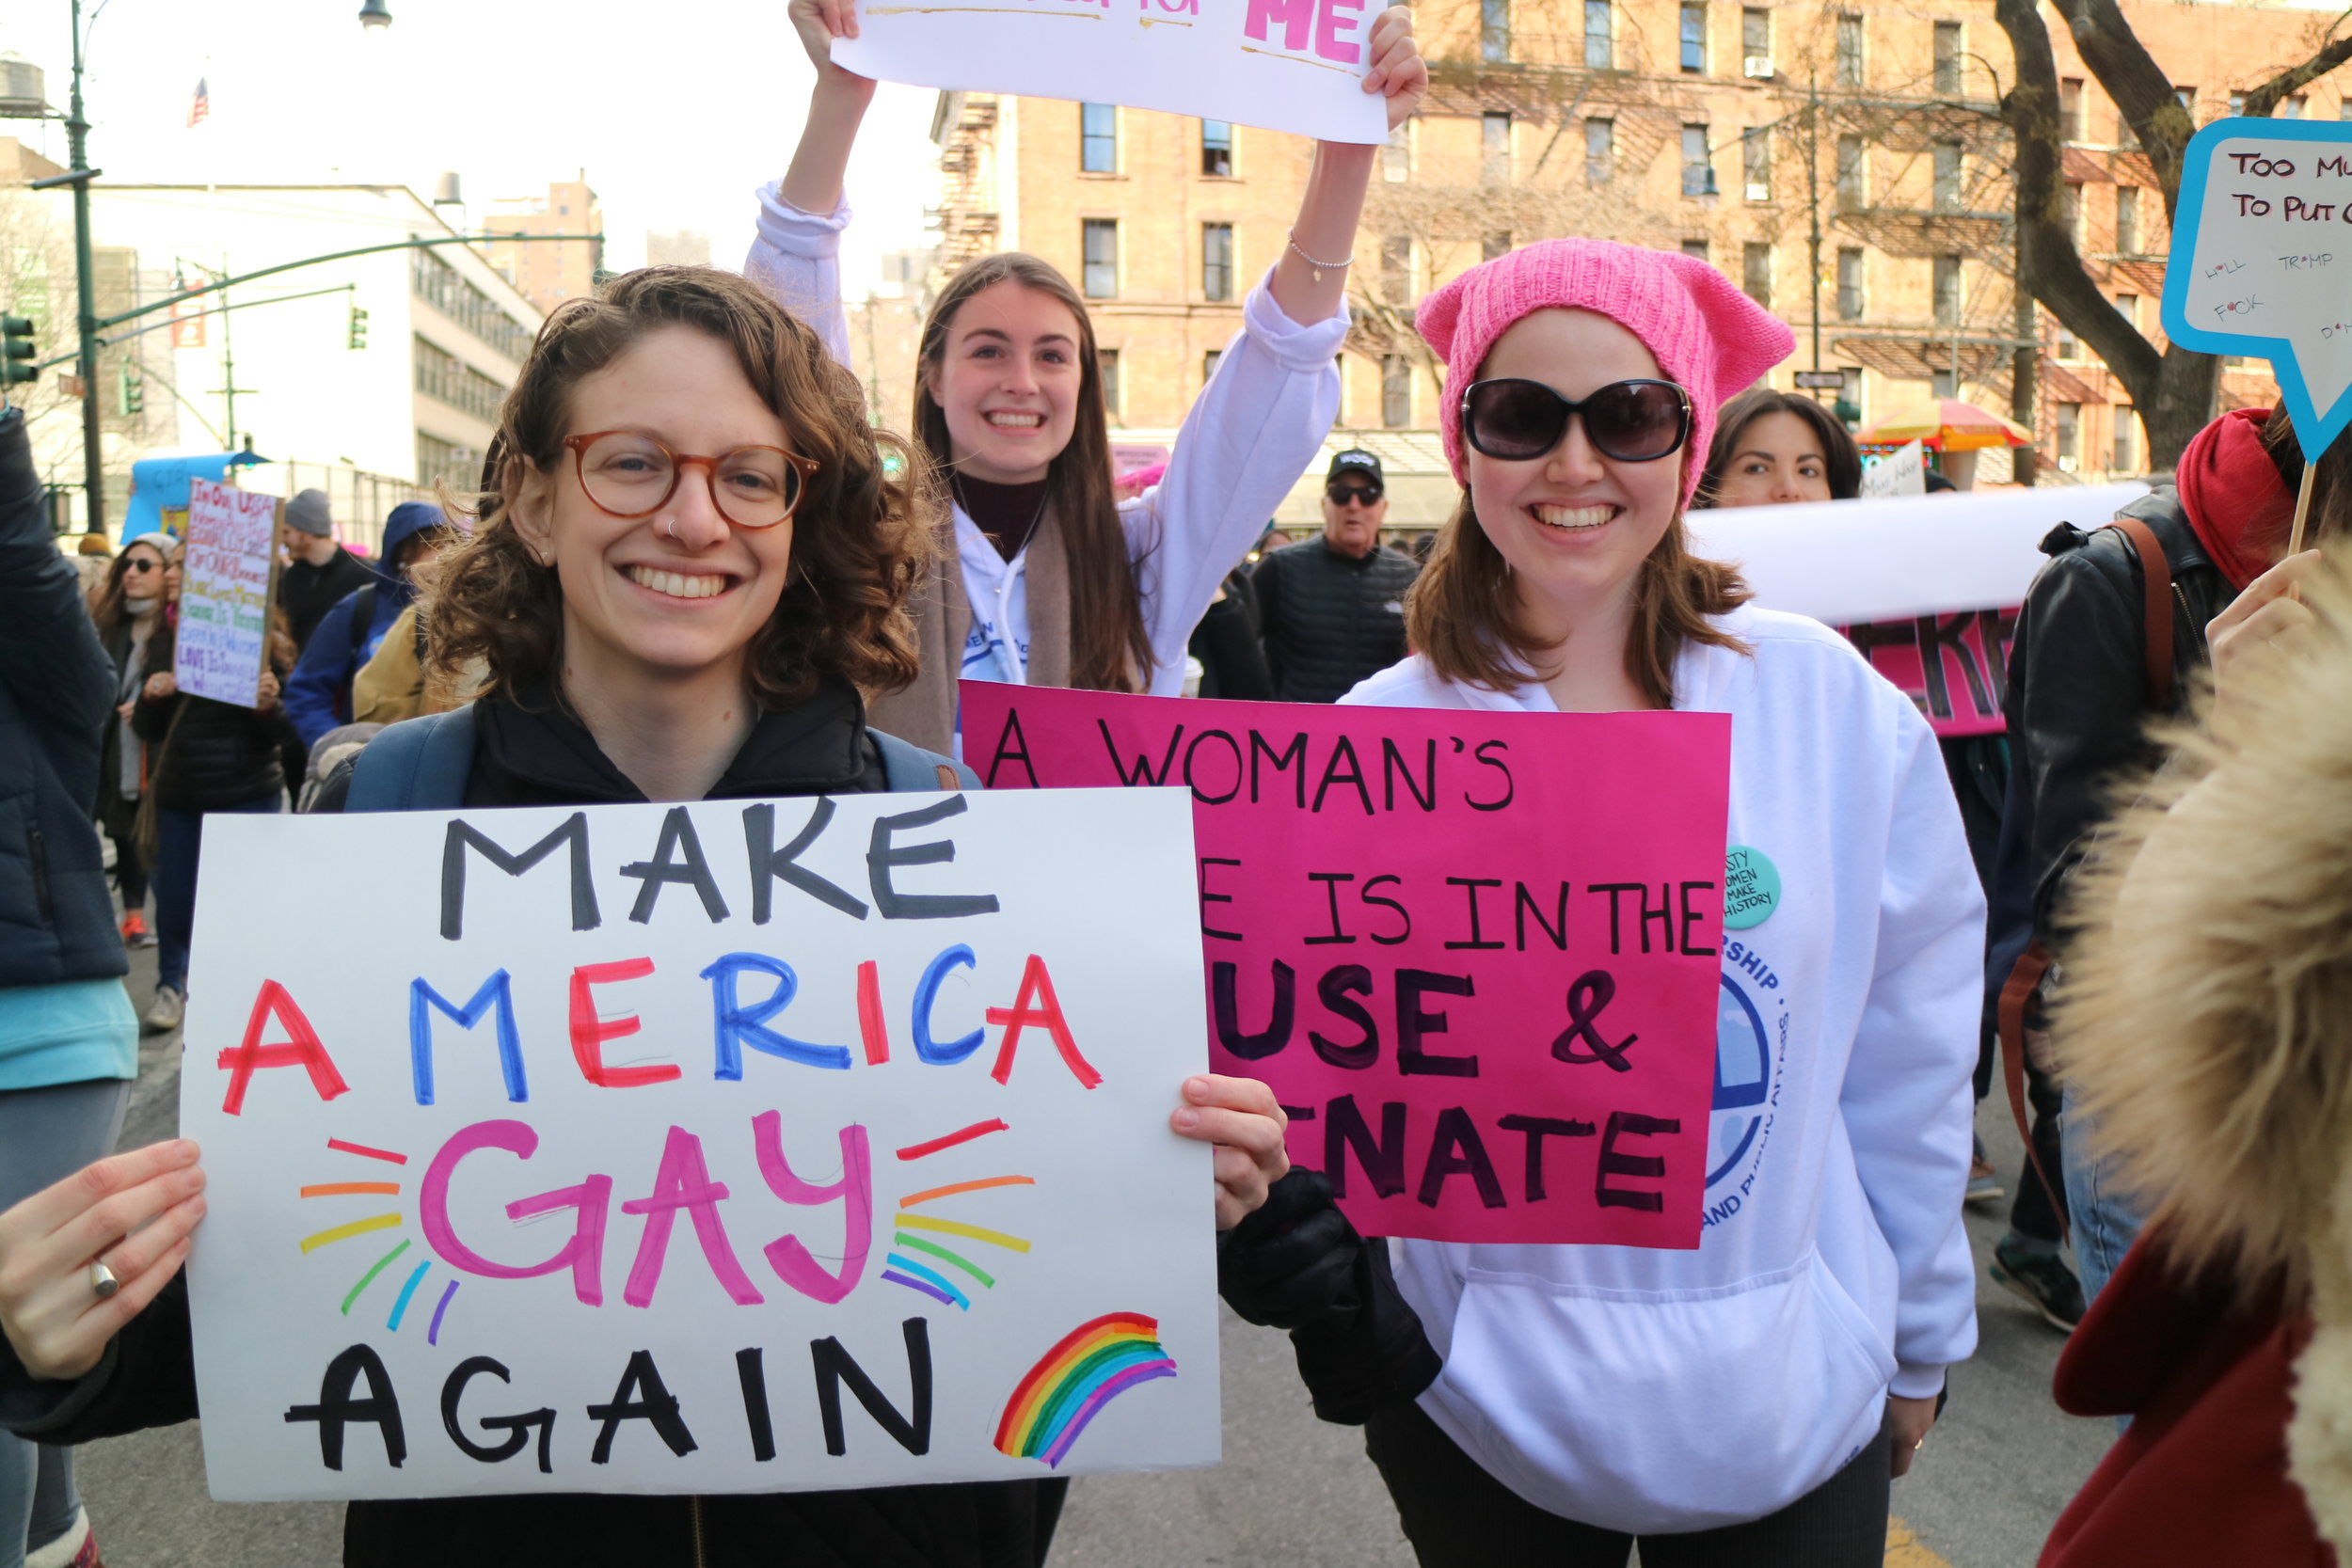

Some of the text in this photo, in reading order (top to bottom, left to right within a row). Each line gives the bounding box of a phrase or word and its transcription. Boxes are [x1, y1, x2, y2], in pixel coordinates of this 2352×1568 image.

[2228, 152, 2296, 178] TOO
[2232, 194, 2271, 217] TO
[2284, 196, 2335, 222] PUT
[986, 707, 1515, 816] A WOMAN'S
[440, 793, 1000, 940] MAKE
[1724, 868, 1756, 888] OMEN
[1724, 891, 1772, 917] HISTORY
[1725, 850, 1747, 871] STY
[1726, 883, 1756, 901] MAKE
[1304, 872, 1412, 945] IS
[1444, 876, 1570, 953] IN
[1587, 880, 1717, 958] THE
[216, 943, 1104, 1116] AMERICA
[1212, 958, 1638, 1078] USE &
[1280, 1094, 1681, 1213] NATE
[420, 1109, 872, 1308] GAY
[284, 1317, 933, 1474] AGAIN
